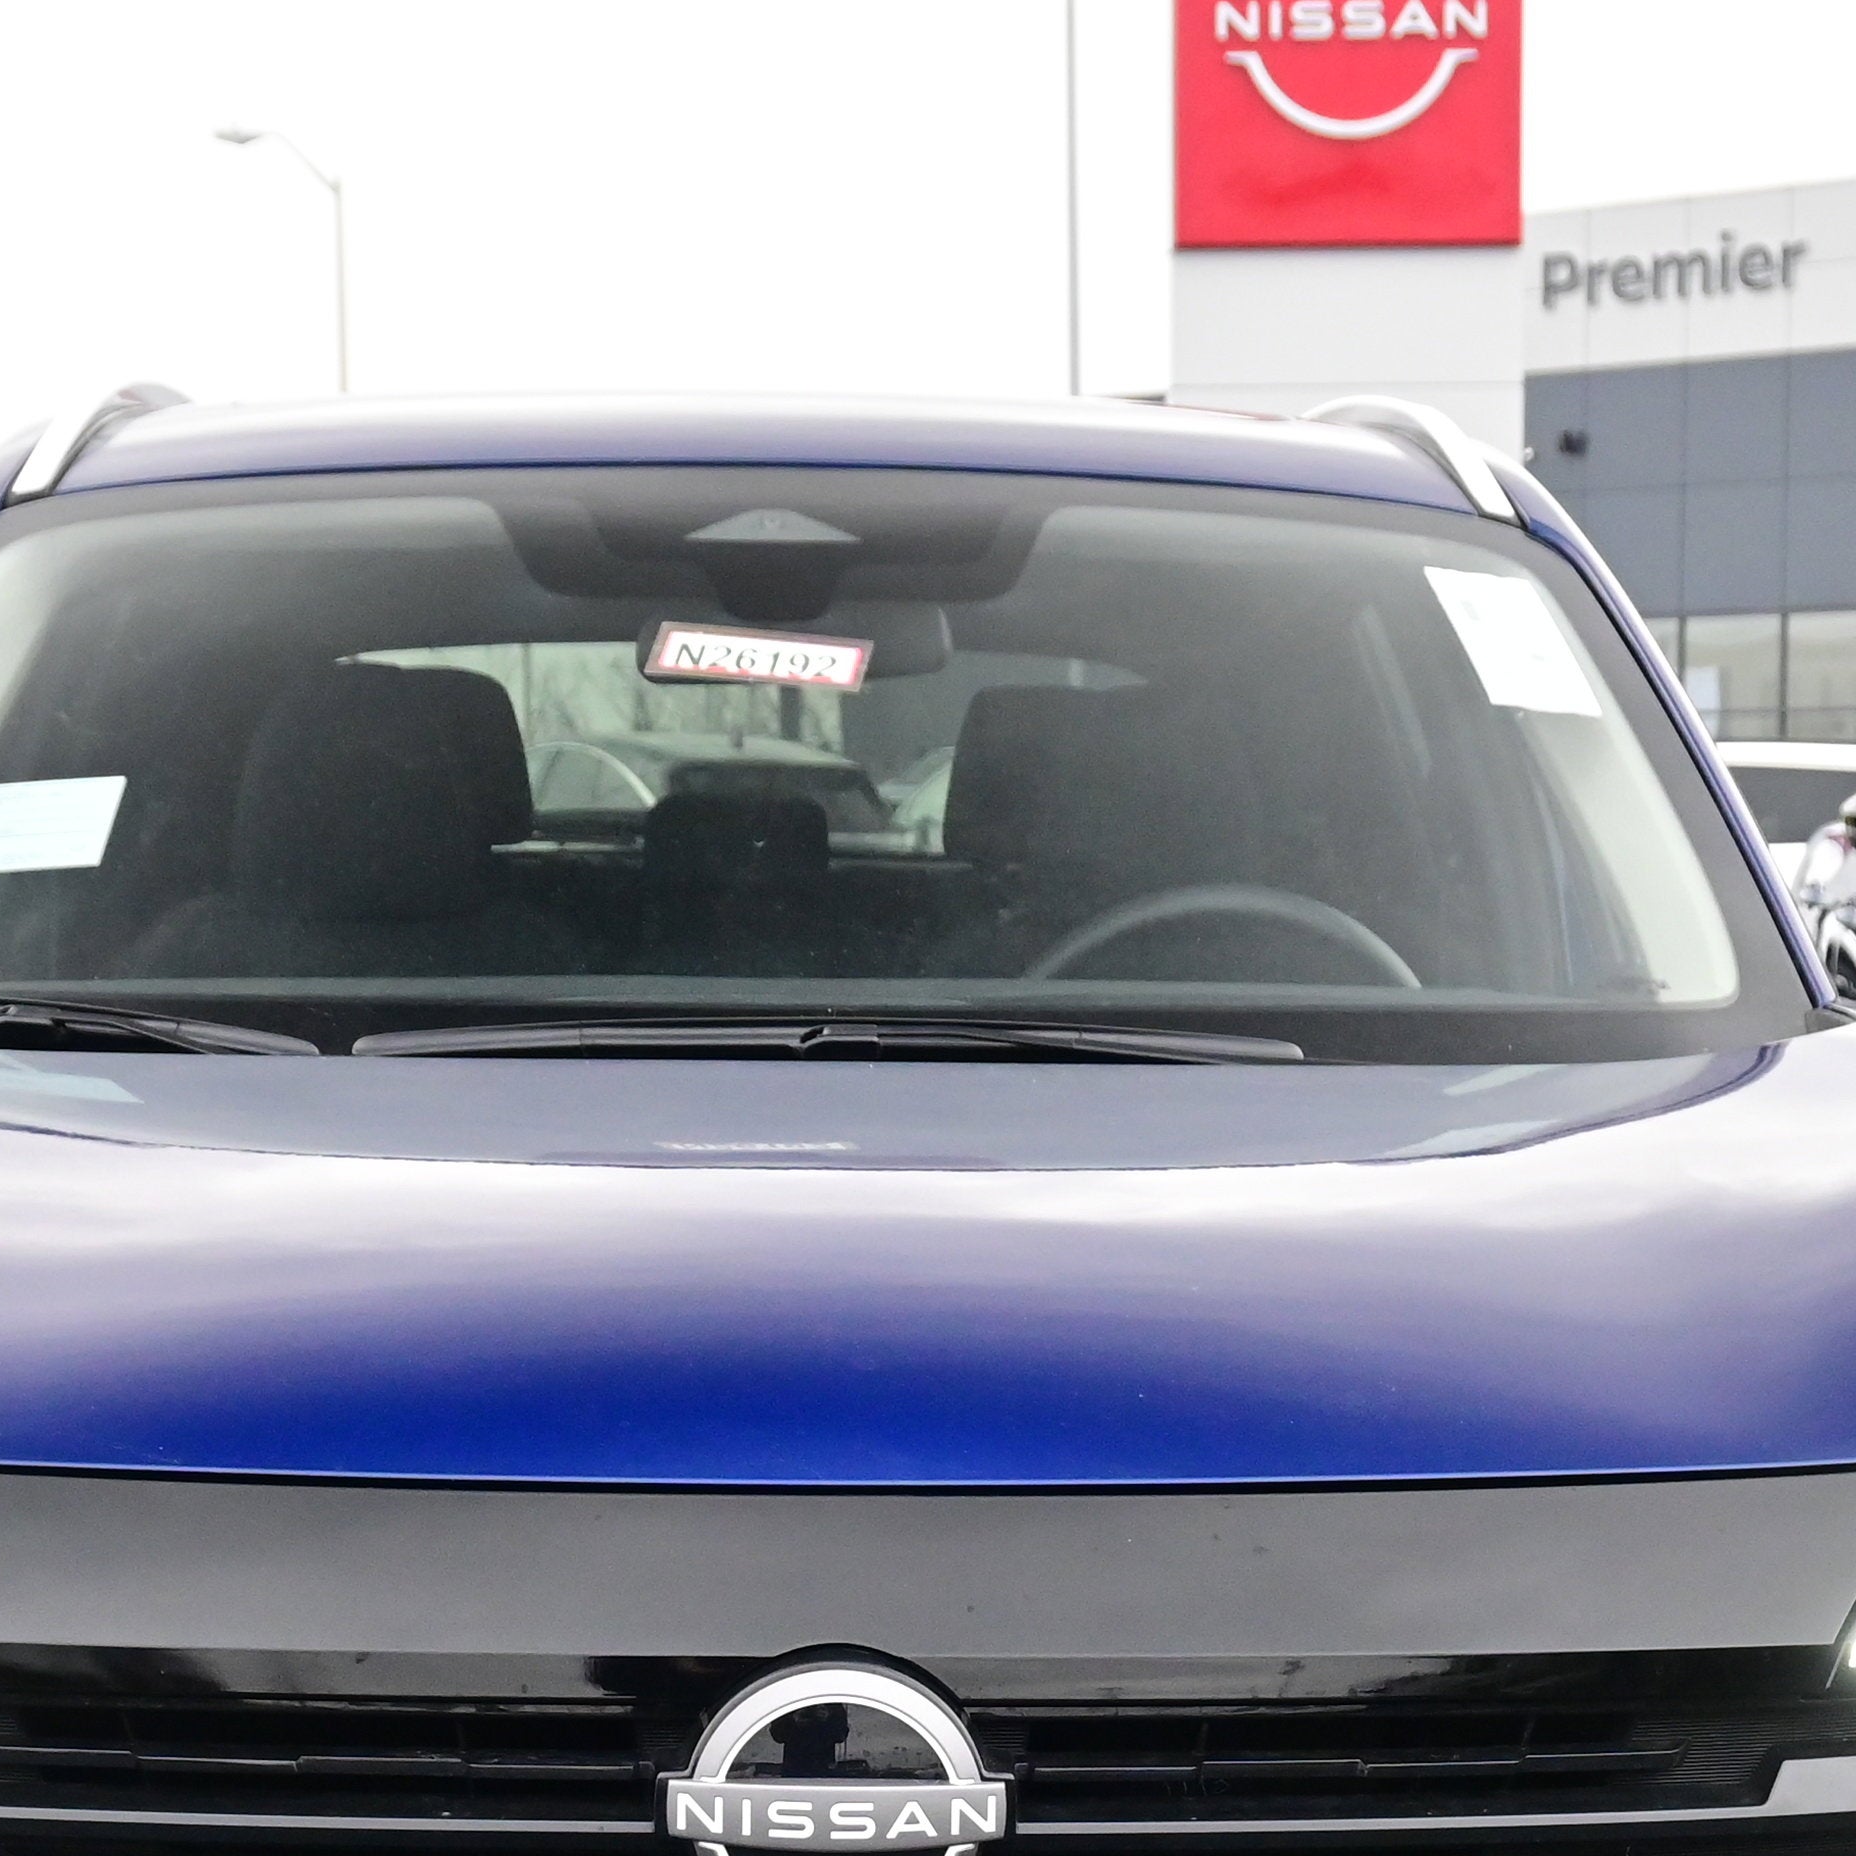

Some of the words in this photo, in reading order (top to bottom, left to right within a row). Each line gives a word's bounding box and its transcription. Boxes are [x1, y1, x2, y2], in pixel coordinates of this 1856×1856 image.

[1213, 0, 1489, 41] NISSAN
[1542, 228, 1808, 309] Premier
[675, 643, 837, 683] N26192
[675, 1792, 998, 1840] NISSAN
